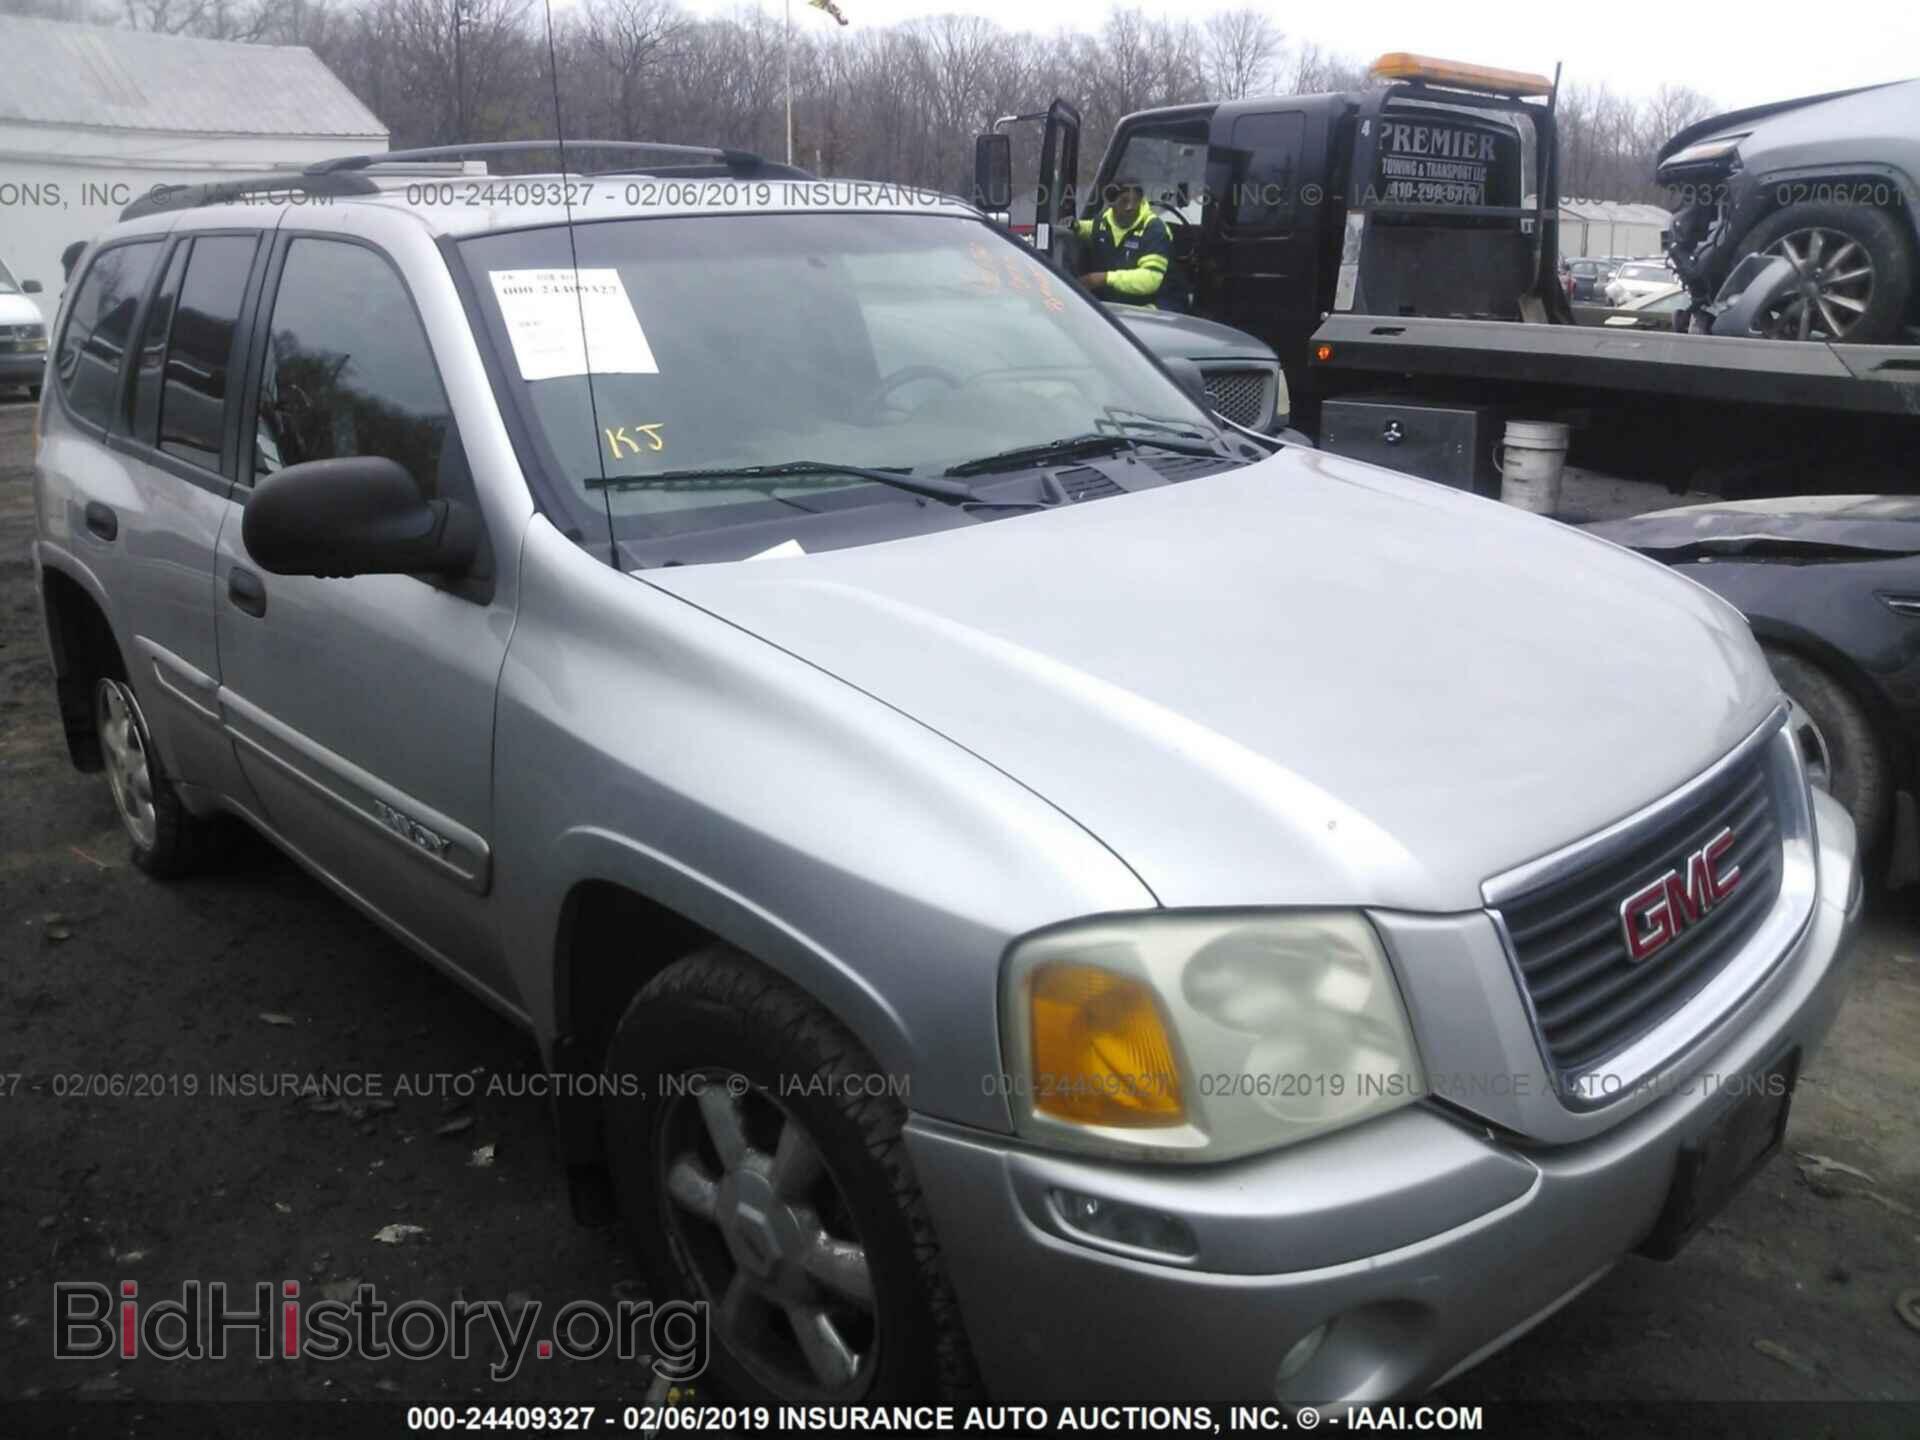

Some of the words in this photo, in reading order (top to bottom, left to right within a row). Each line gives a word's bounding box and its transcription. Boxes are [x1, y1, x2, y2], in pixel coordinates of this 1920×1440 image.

[1360, 118, 1371, 137] 4
[1378, 121, 1497, 161] PREMIER
[1619, 826, 1741, 961] GMC
